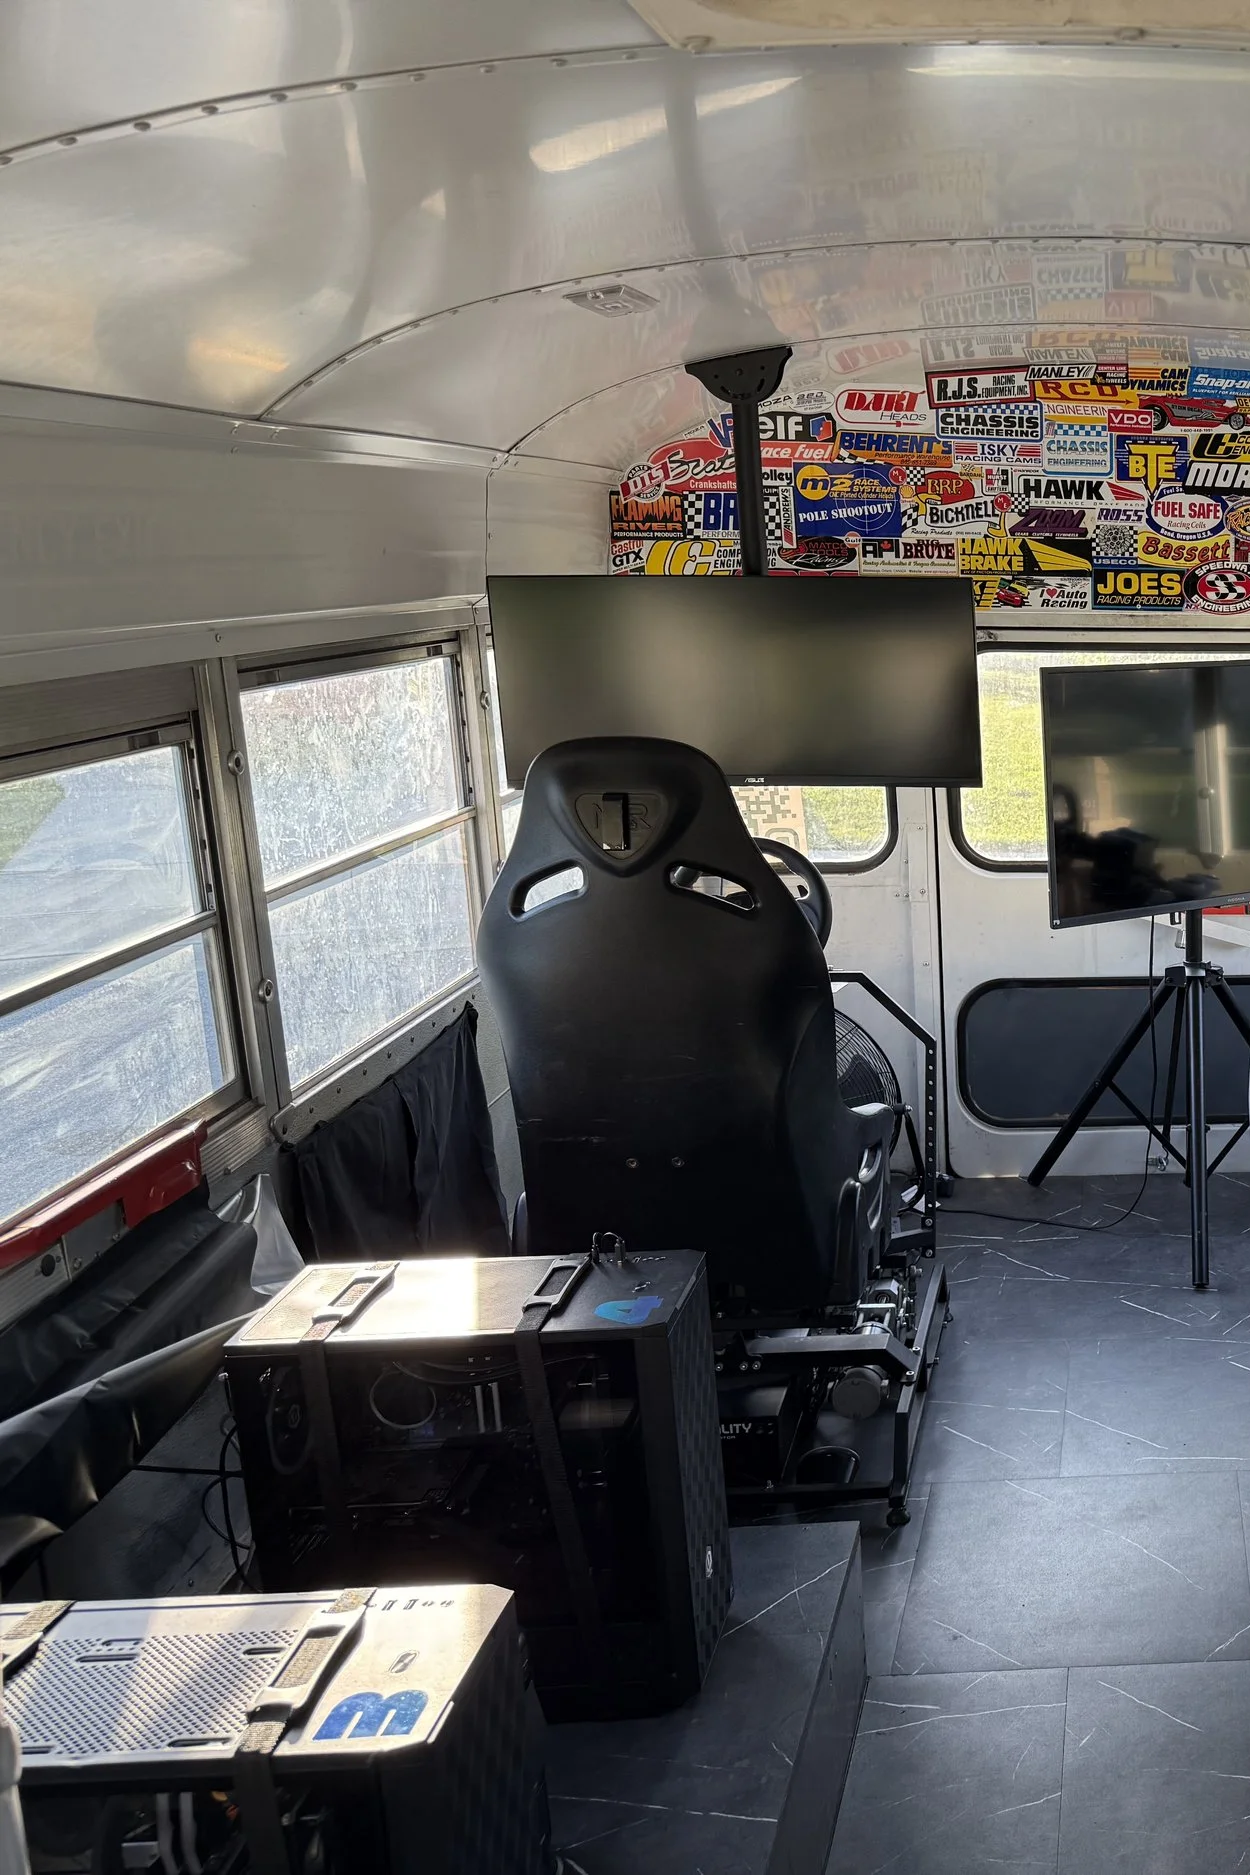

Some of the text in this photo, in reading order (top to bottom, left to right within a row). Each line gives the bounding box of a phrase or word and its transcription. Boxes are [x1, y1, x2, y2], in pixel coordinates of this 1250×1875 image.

[993, 375, 1015, 385] RACING
[1029, 367, 1084, 379] MANLEY
[1161, 369, 1188, 379] CAM
[937, 377, 981, 401] R.J.S.
[1121, 380, 1186, 392] DYNAMICS
[844, 391, 926, 412] DART
[880, 412, 927, 421] HEADS
[940, 413, 1039, 429] CHASSIS
[1110, 413, 1150, 424] VDO
[759, 416, 802, 440] elf
[941, 427, 1039, 438] ENGINEERING
[840, 432, 952, 454] BEHRENT'S
[980, 444, 1019, 456] ISKY
[1046, 440, 1108, 455] CHASSIS
[794, 444, 833, 459] Fuel
[956, 455, 1042, 464] RACING CAMS
[1048, 458, 1107, 467] ENGINEERING
[690, 480, 736, 489] Crankshafts
[762, 469, 792, 485] olley
[1024, 478, 1104, 500] HAWK
[781, 488, 790, 529] ANDREWS
[799, 511, 828, 522] POLE
[831, 503, 892, 518] SHOOTOUT
[1098, 508, 1145, 522] ROSS
[1154, 501, 1220, 519] FUEL SAFE
[1167, 521, 1190, 529] Racing
[902, 542, 955, 559] BRUTE
[959, 538, 1023, 555] HAWK
[1142, 536, 1230, 562] Bassett
[613, 549, 644, 567] GTX
[960, 557, 1023, 571] BRAKE
[1195, 561, 1249, 576] SPEEDWA
[1097, 572, 1182, 595] JOES
[1056, 589, 1087, 599] Auto
[1097, 595, 1181, 605] RACING PRODUCTS
[1041, 599, 1087, 609] Racing
